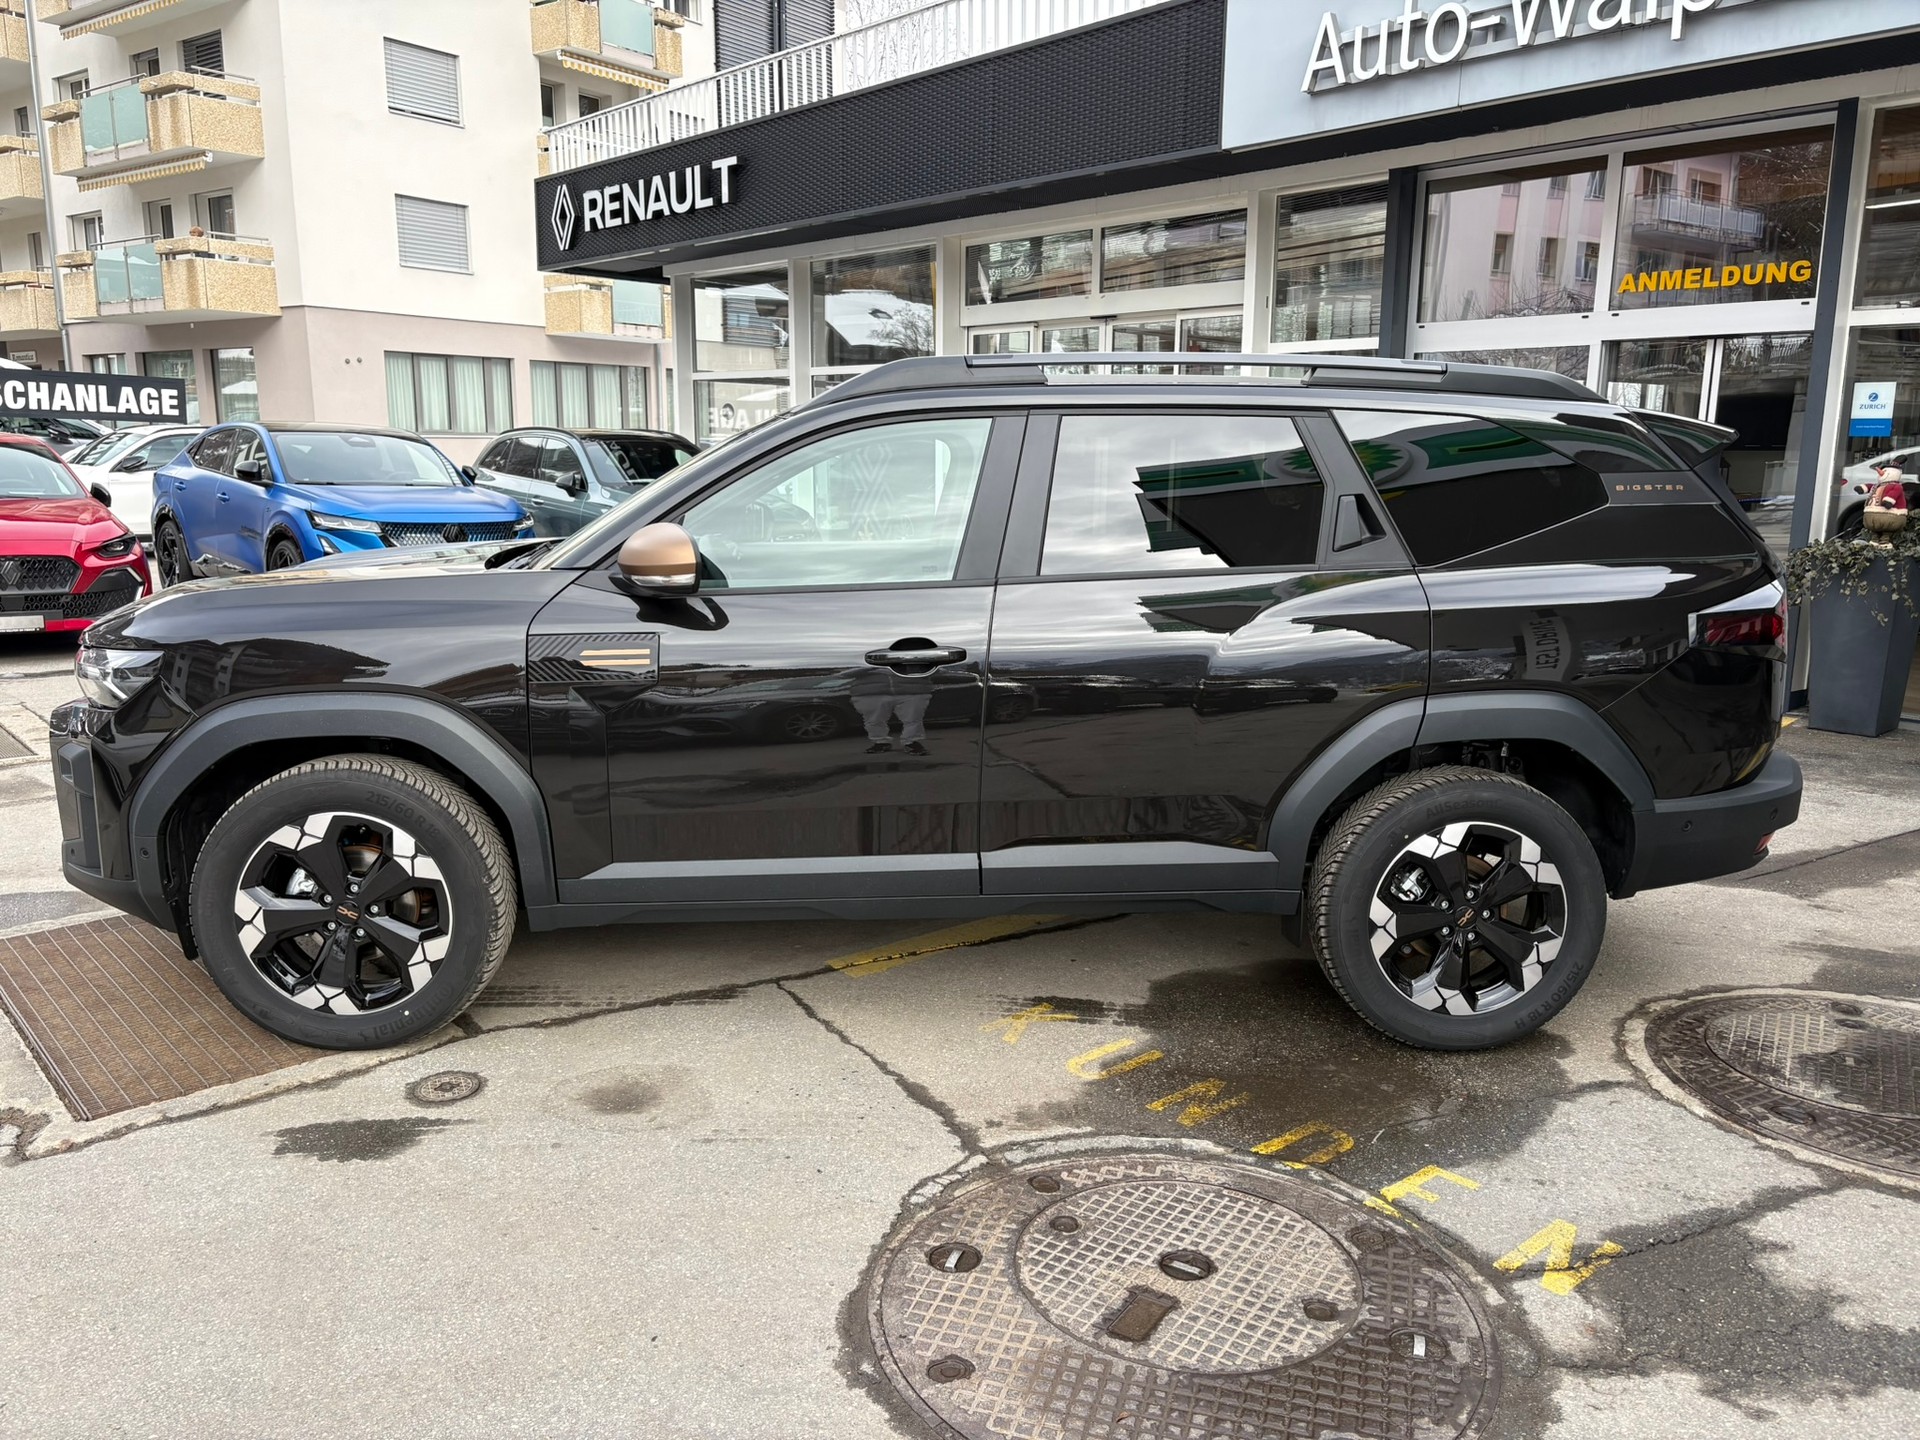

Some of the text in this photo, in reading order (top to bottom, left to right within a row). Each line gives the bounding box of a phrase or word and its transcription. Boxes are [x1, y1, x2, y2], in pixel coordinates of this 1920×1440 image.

[1300, 0, 1733, 93] Auto-Wap
[583, 156, 738, 232] RENAULT
[1617, 260, 1812, 293] ANMELDUNG
[0, 379, 180, 416] CHANLAGE
[365, 790, 415, 819] 215/60
[1551, 961, 1584, 1002] 215/60
